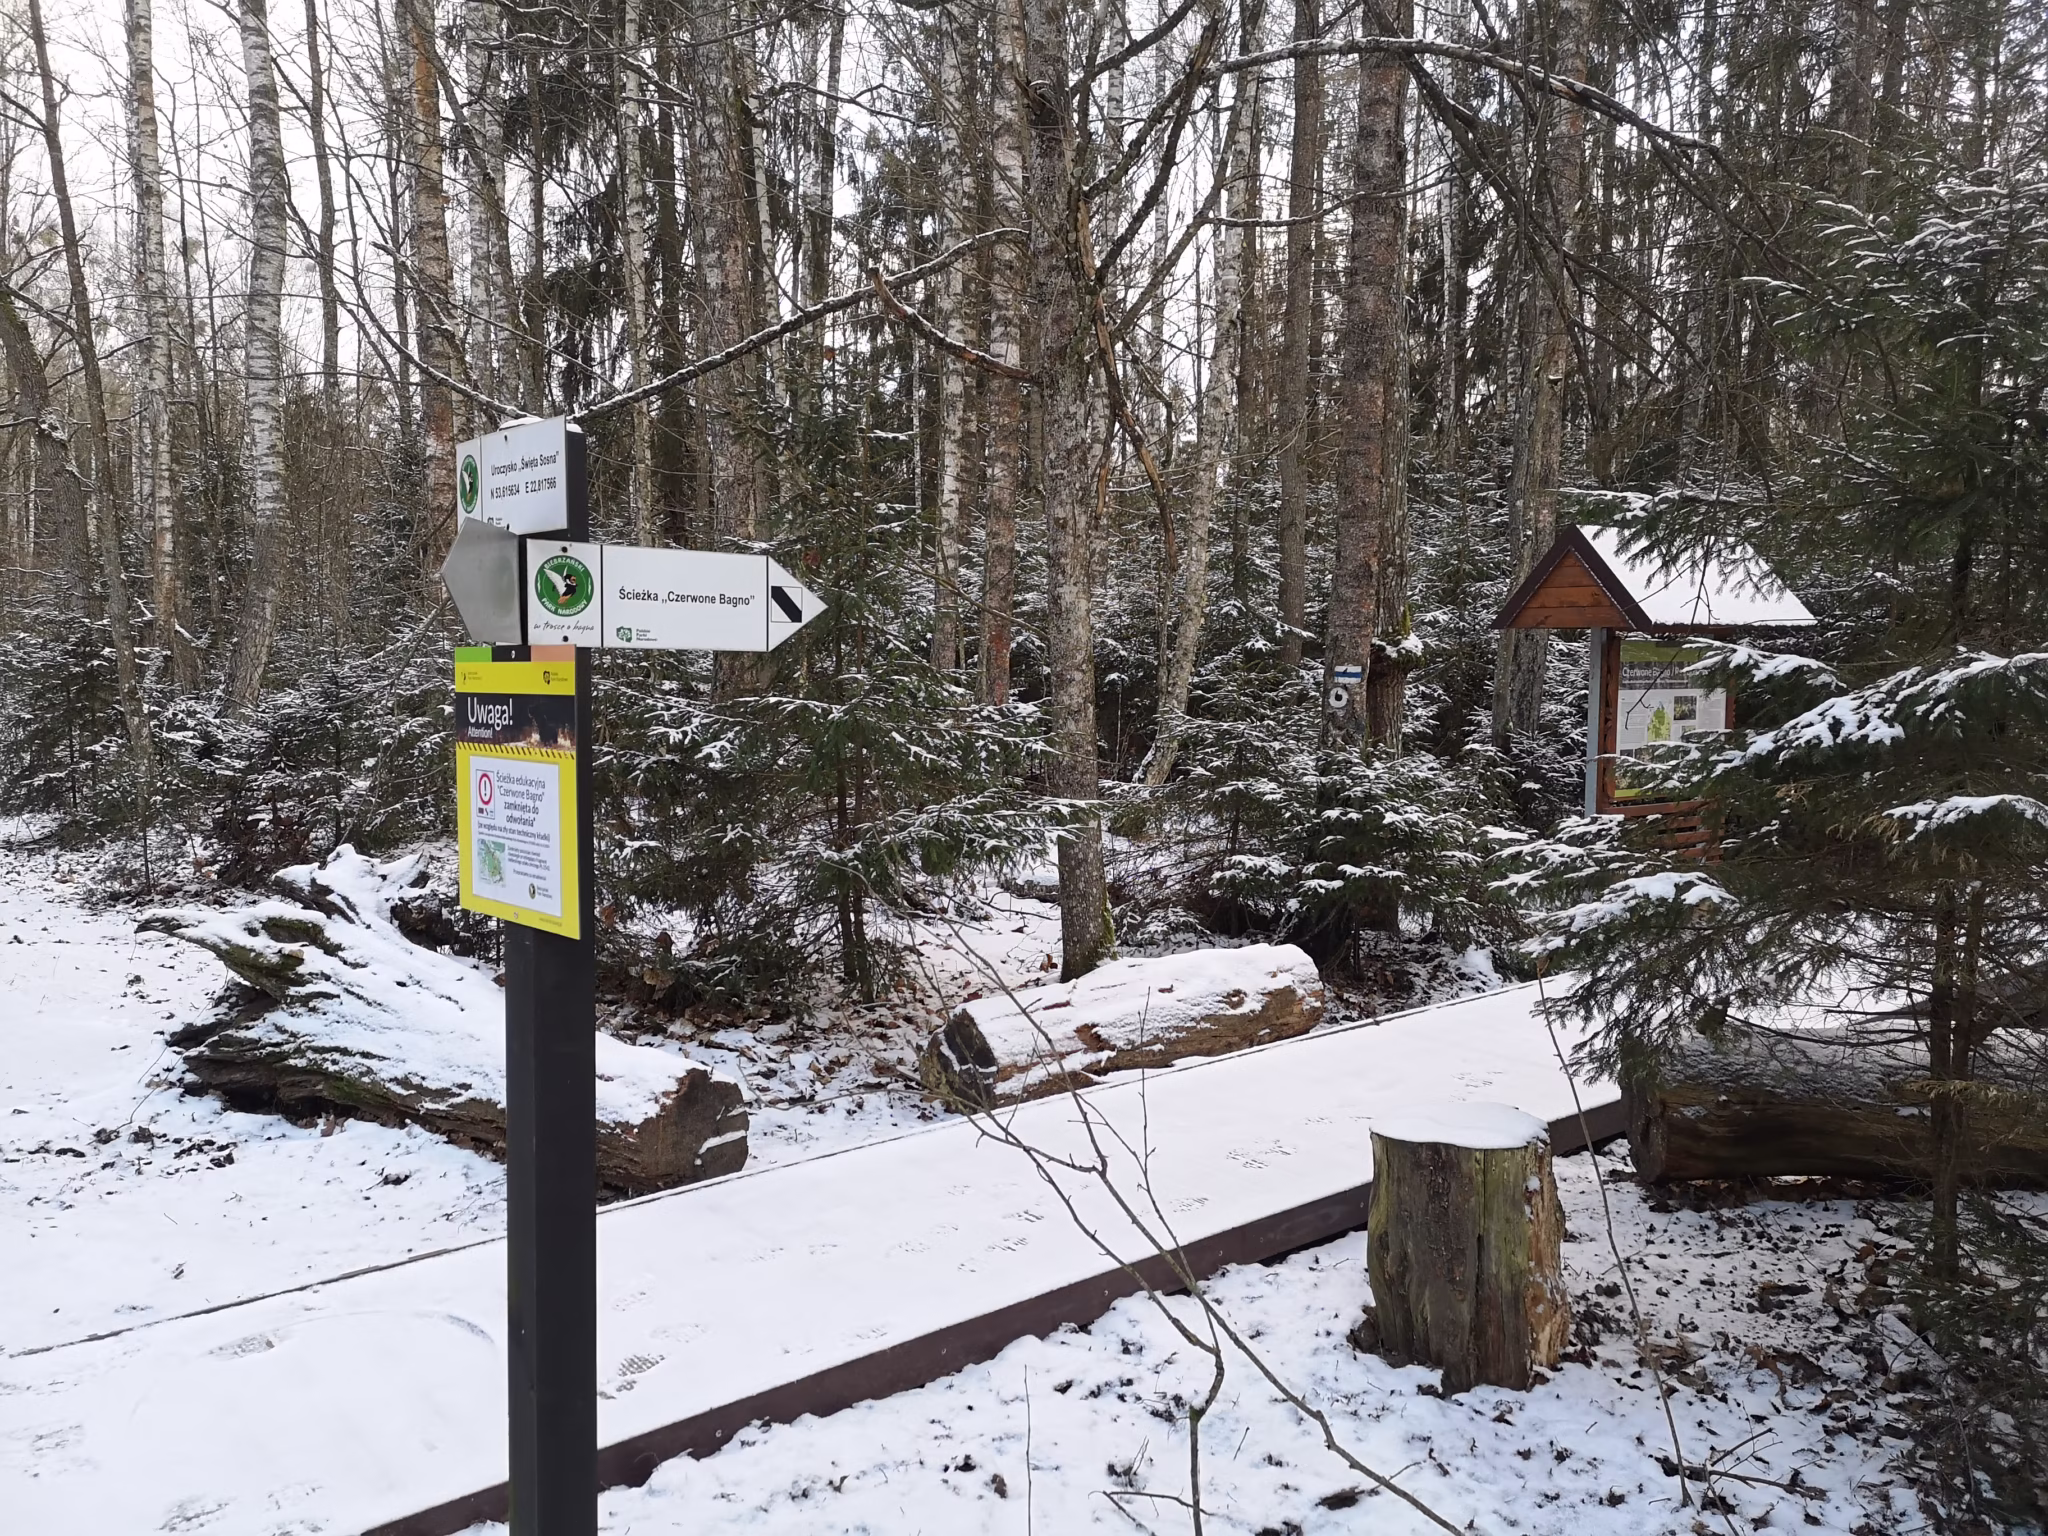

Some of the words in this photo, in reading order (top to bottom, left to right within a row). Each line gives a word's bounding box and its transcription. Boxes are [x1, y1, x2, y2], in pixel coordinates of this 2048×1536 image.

[490, 460, 517, 476] Uroczysko
[490, 488, 494, 500] N
[525, 481, 529, 493] E
[619, 586, 659, 601] Ścieżka
[542, 598, 556, 612] PARK
[558, 600, 588, 615] NARODOWY
[1622, 667, 1652, 676] Czerwone
[468, 696, 513, 731] Uwaga!
[468, 726, 493, 739] Attention!
[496, 770, 515, 785] Ścieżka
[516, 775, 546, 791] edukacyjna
[504, 800, 531, 815] zamknięta
[532, 804, 539, 815] do
